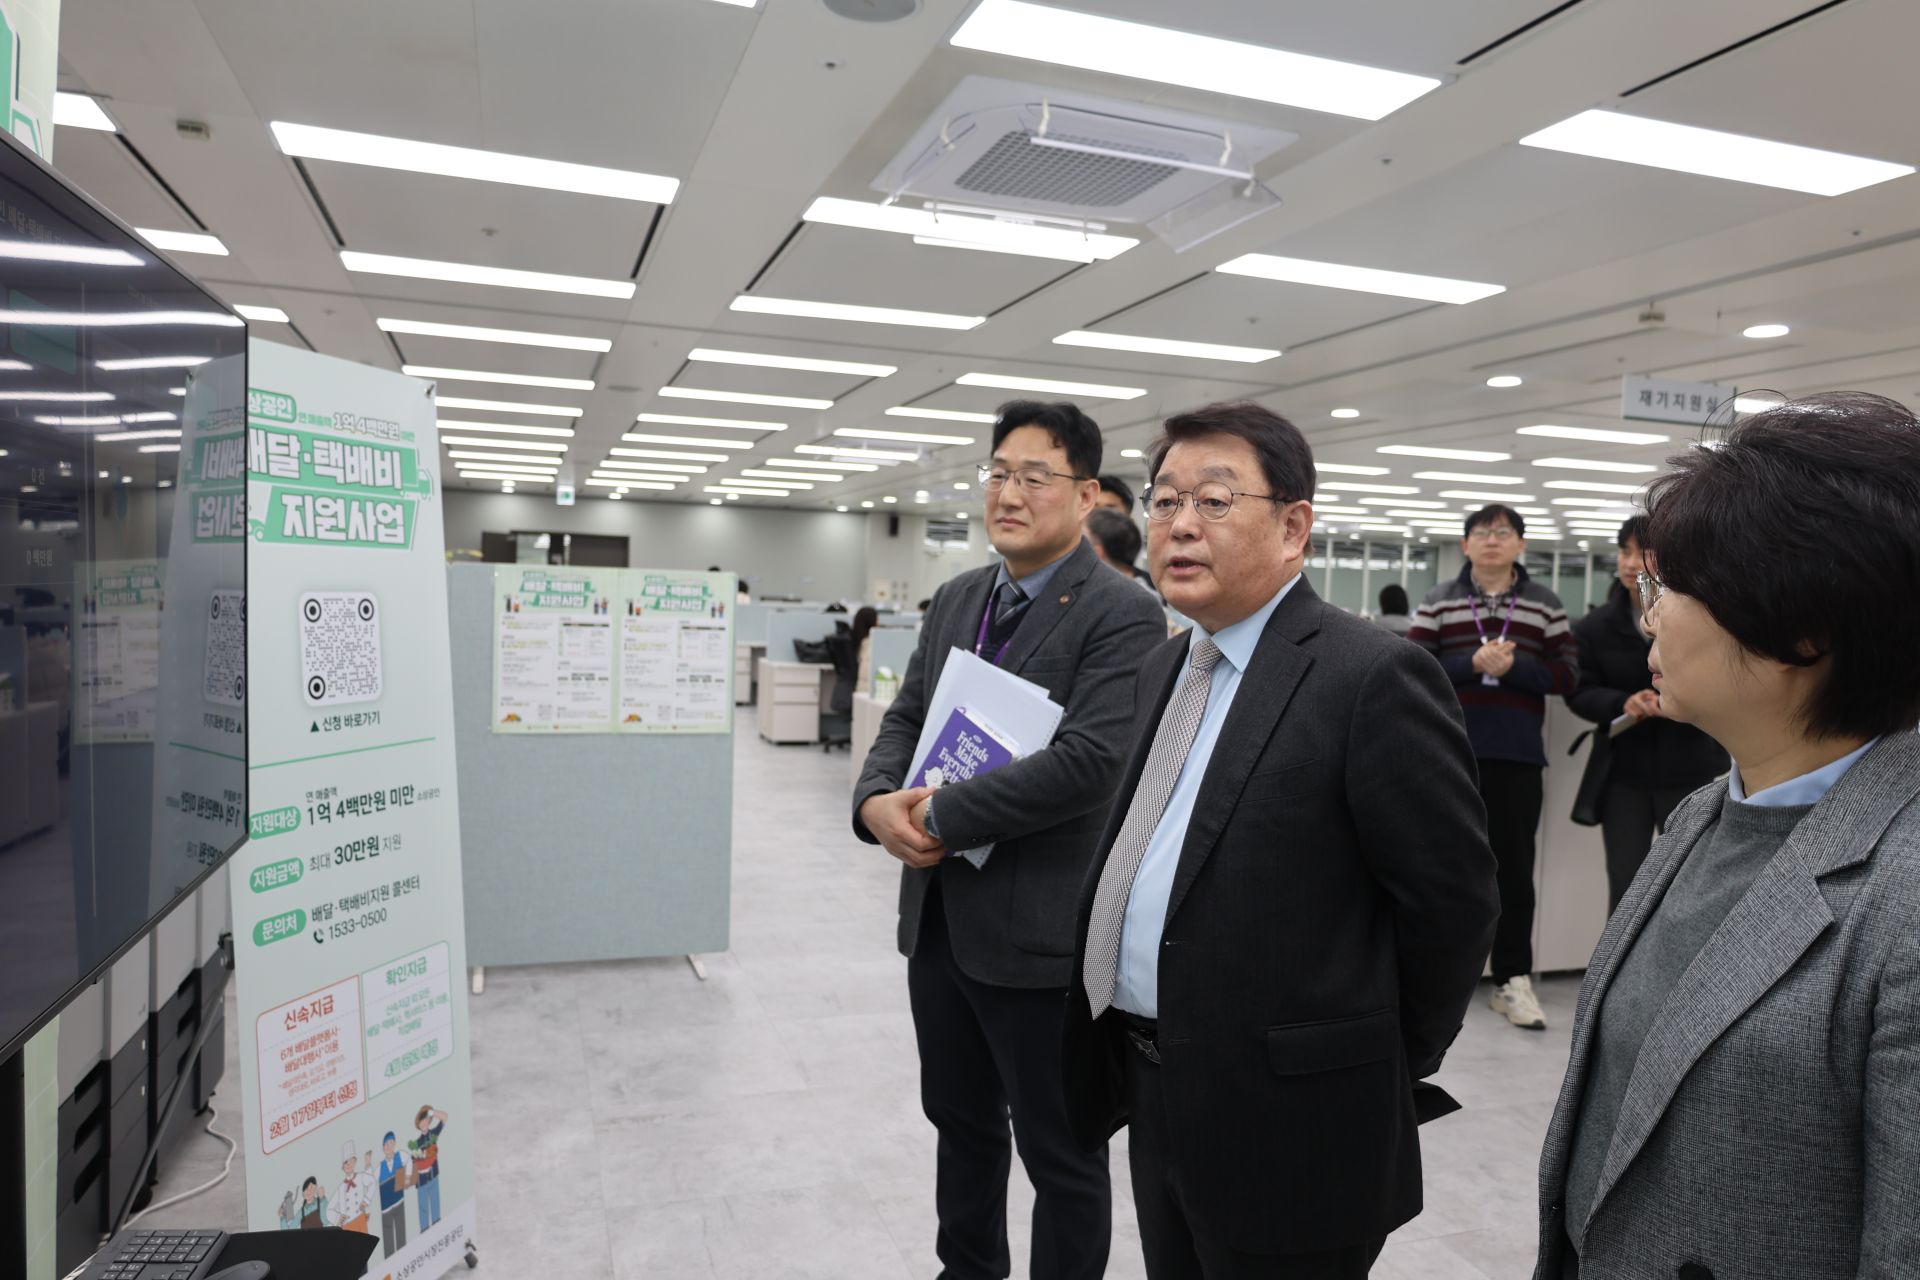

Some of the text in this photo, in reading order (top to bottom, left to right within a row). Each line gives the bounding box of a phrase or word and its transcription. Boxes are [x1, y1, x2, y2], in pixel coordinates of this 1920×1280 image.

[281, 494, 405, 544] 지원사업
[322, 711, 381, 732] 신청 바로가기
[954, 745, 979, 770] Make
[957, 730, 989, 763] Friends
[251, 809, 298, 834] 지원대상
[306, 803, 331, 826] 1억
[336, 790, 386, 819] 4백만원
[390, 785, 415, 806] 미만
[309, 834, 402, 872] 최대 30만원 지원
[254, 861, 301, 888] 지원금액
[312, 875, 420, 923] 배달·택배비지원 콜센터
[261, 914, 298, 942] 문의처
[329, 908, 388, 940] 1533-0500
[385, 956, 427, 986] 확인지급
[284, 994, 335, 1032] 신속지급
[280, 1046, 294, 1061] 6개
[270, 1114, 290, 1140] 2월
[291, 1090, 337, 1128] 17일부터
